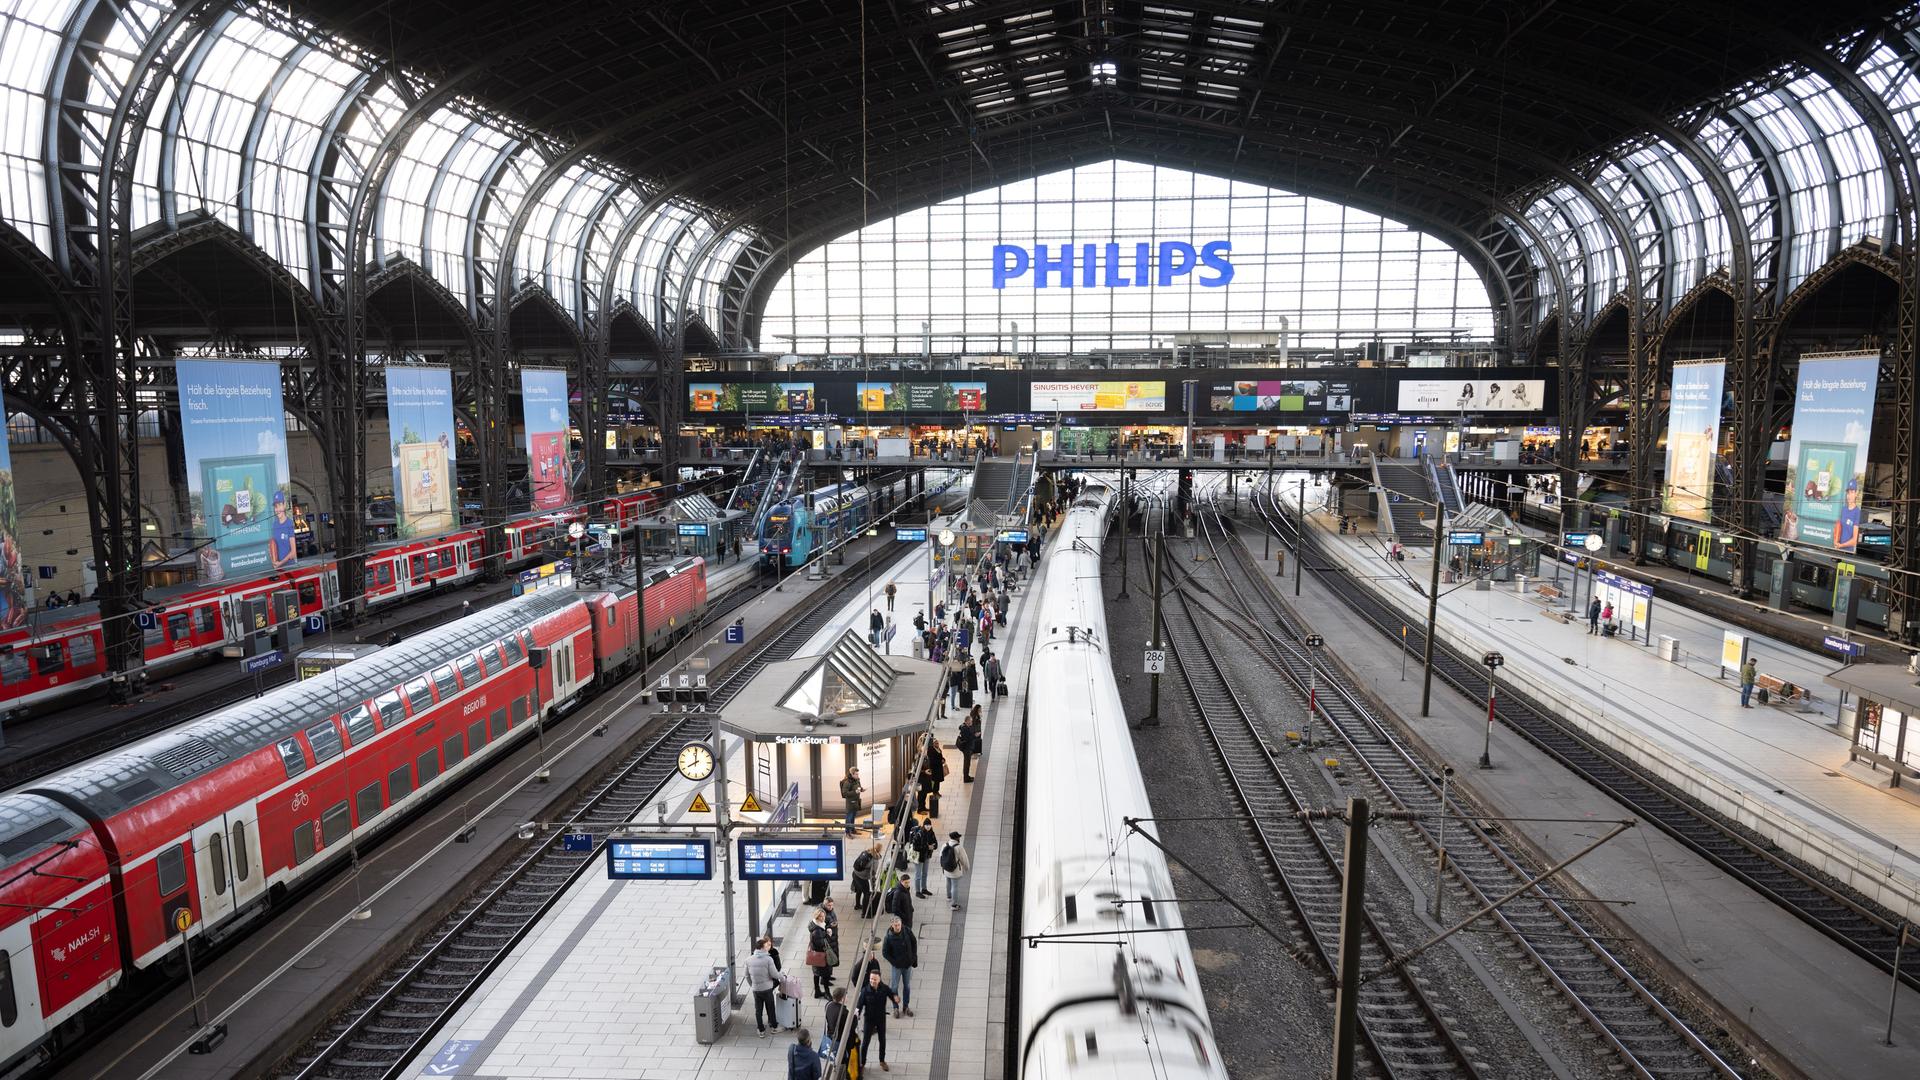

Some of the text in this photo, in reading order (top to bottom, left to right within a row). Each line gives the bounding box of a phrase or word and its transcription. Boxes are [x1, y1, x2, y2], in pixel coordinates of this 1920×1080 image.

[993, 241, 1234, 289] PHILIPS
[187, 384, 271, 398] Hält die längste Beziehung
[1822, 379, 1840, 391] längste
[1840, 379, 1866, 391] Beziehung
[189, 399, 208, 410] frisch.
[139, 613, 149, 626] D
[311, 617, 321, 630] D
[728, 628, 737, 641] E
[1824, 637, 1851, 651] Hamburg Hbf
[1146, 652, 1163, 661] 286
[250, 658, 268, 669] Hamburg
[1151, 662, 1157, 671] 6
[464, 699, 480, 716] REGIO
[776, 736, 828, 744] ServiceStore
[315, 820, 320, 832] 2
[618, 844, 625, 855] 7
[830, 845, 836, 856] 8
[68, 926, 100, 952] NAH.SH
